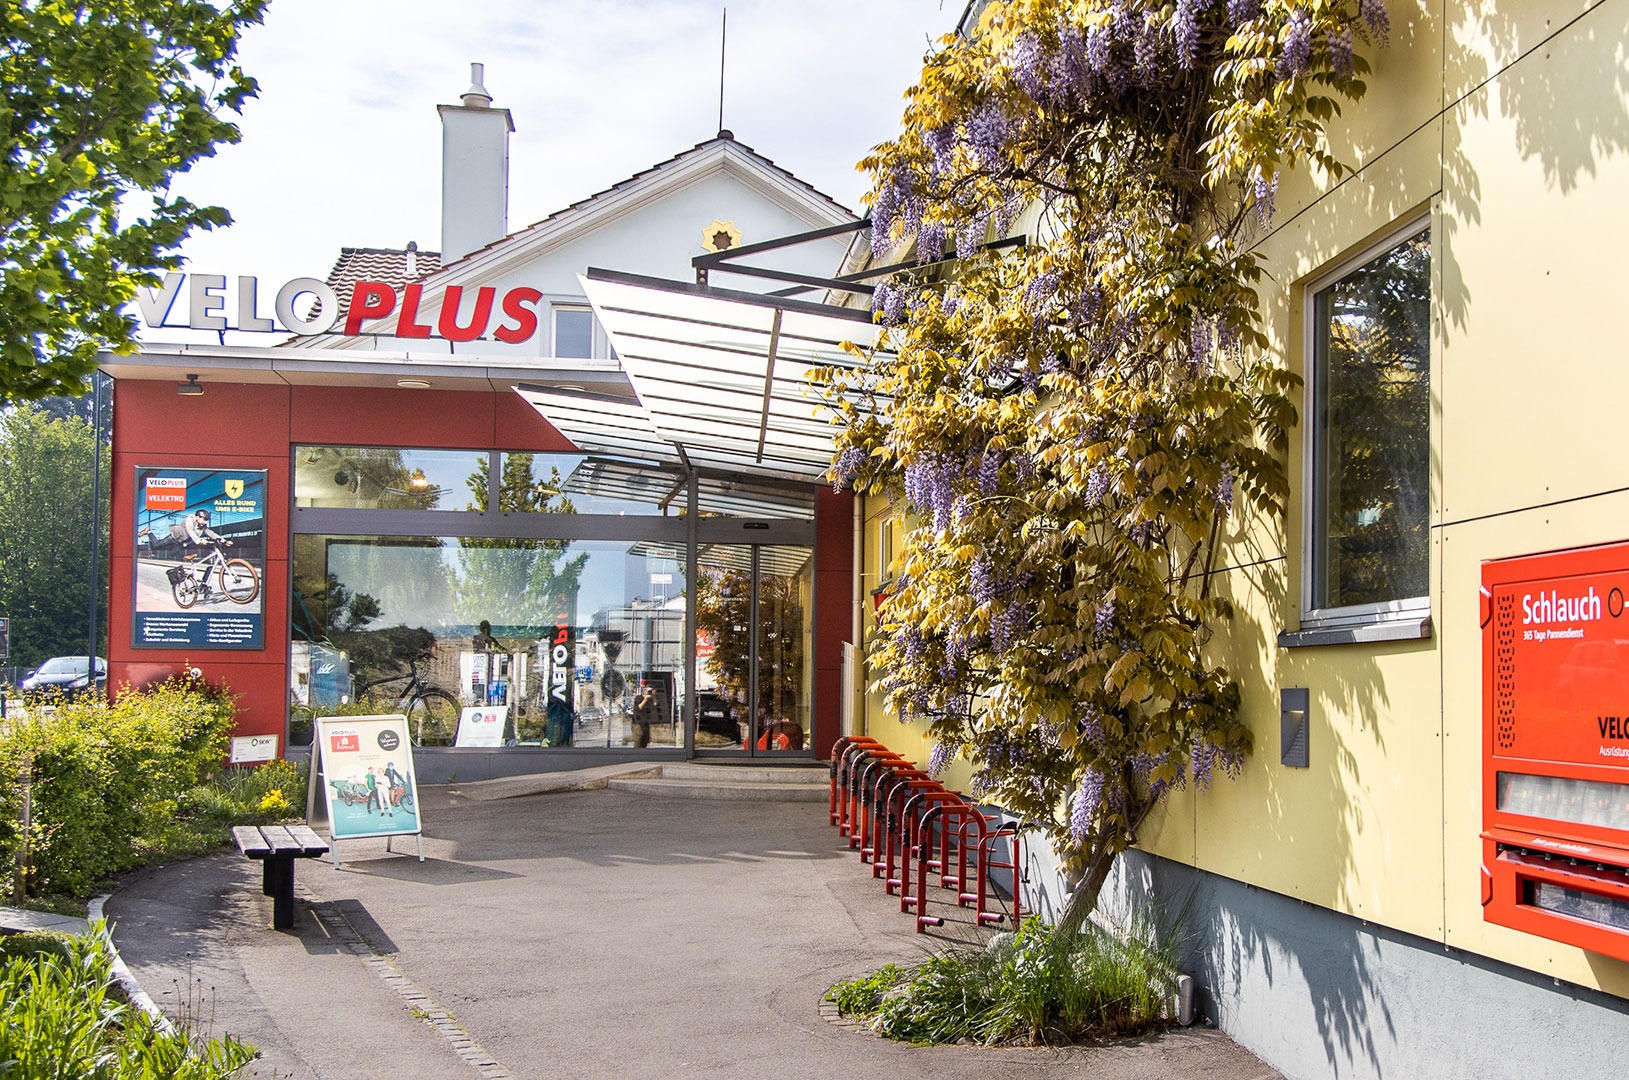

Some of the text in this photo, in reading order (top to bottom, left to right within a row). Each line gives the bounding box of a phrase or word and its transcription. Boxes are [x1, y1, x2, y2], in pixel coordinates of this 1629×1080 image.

[138, 273, 543, 345] VELOPLUS
[148, 494, 184, 503] VELEKTRO
[1522, 586, 1601, 625] Schlauch
[1523, 628, 1585, 642] 365 Tage Pannendienst
